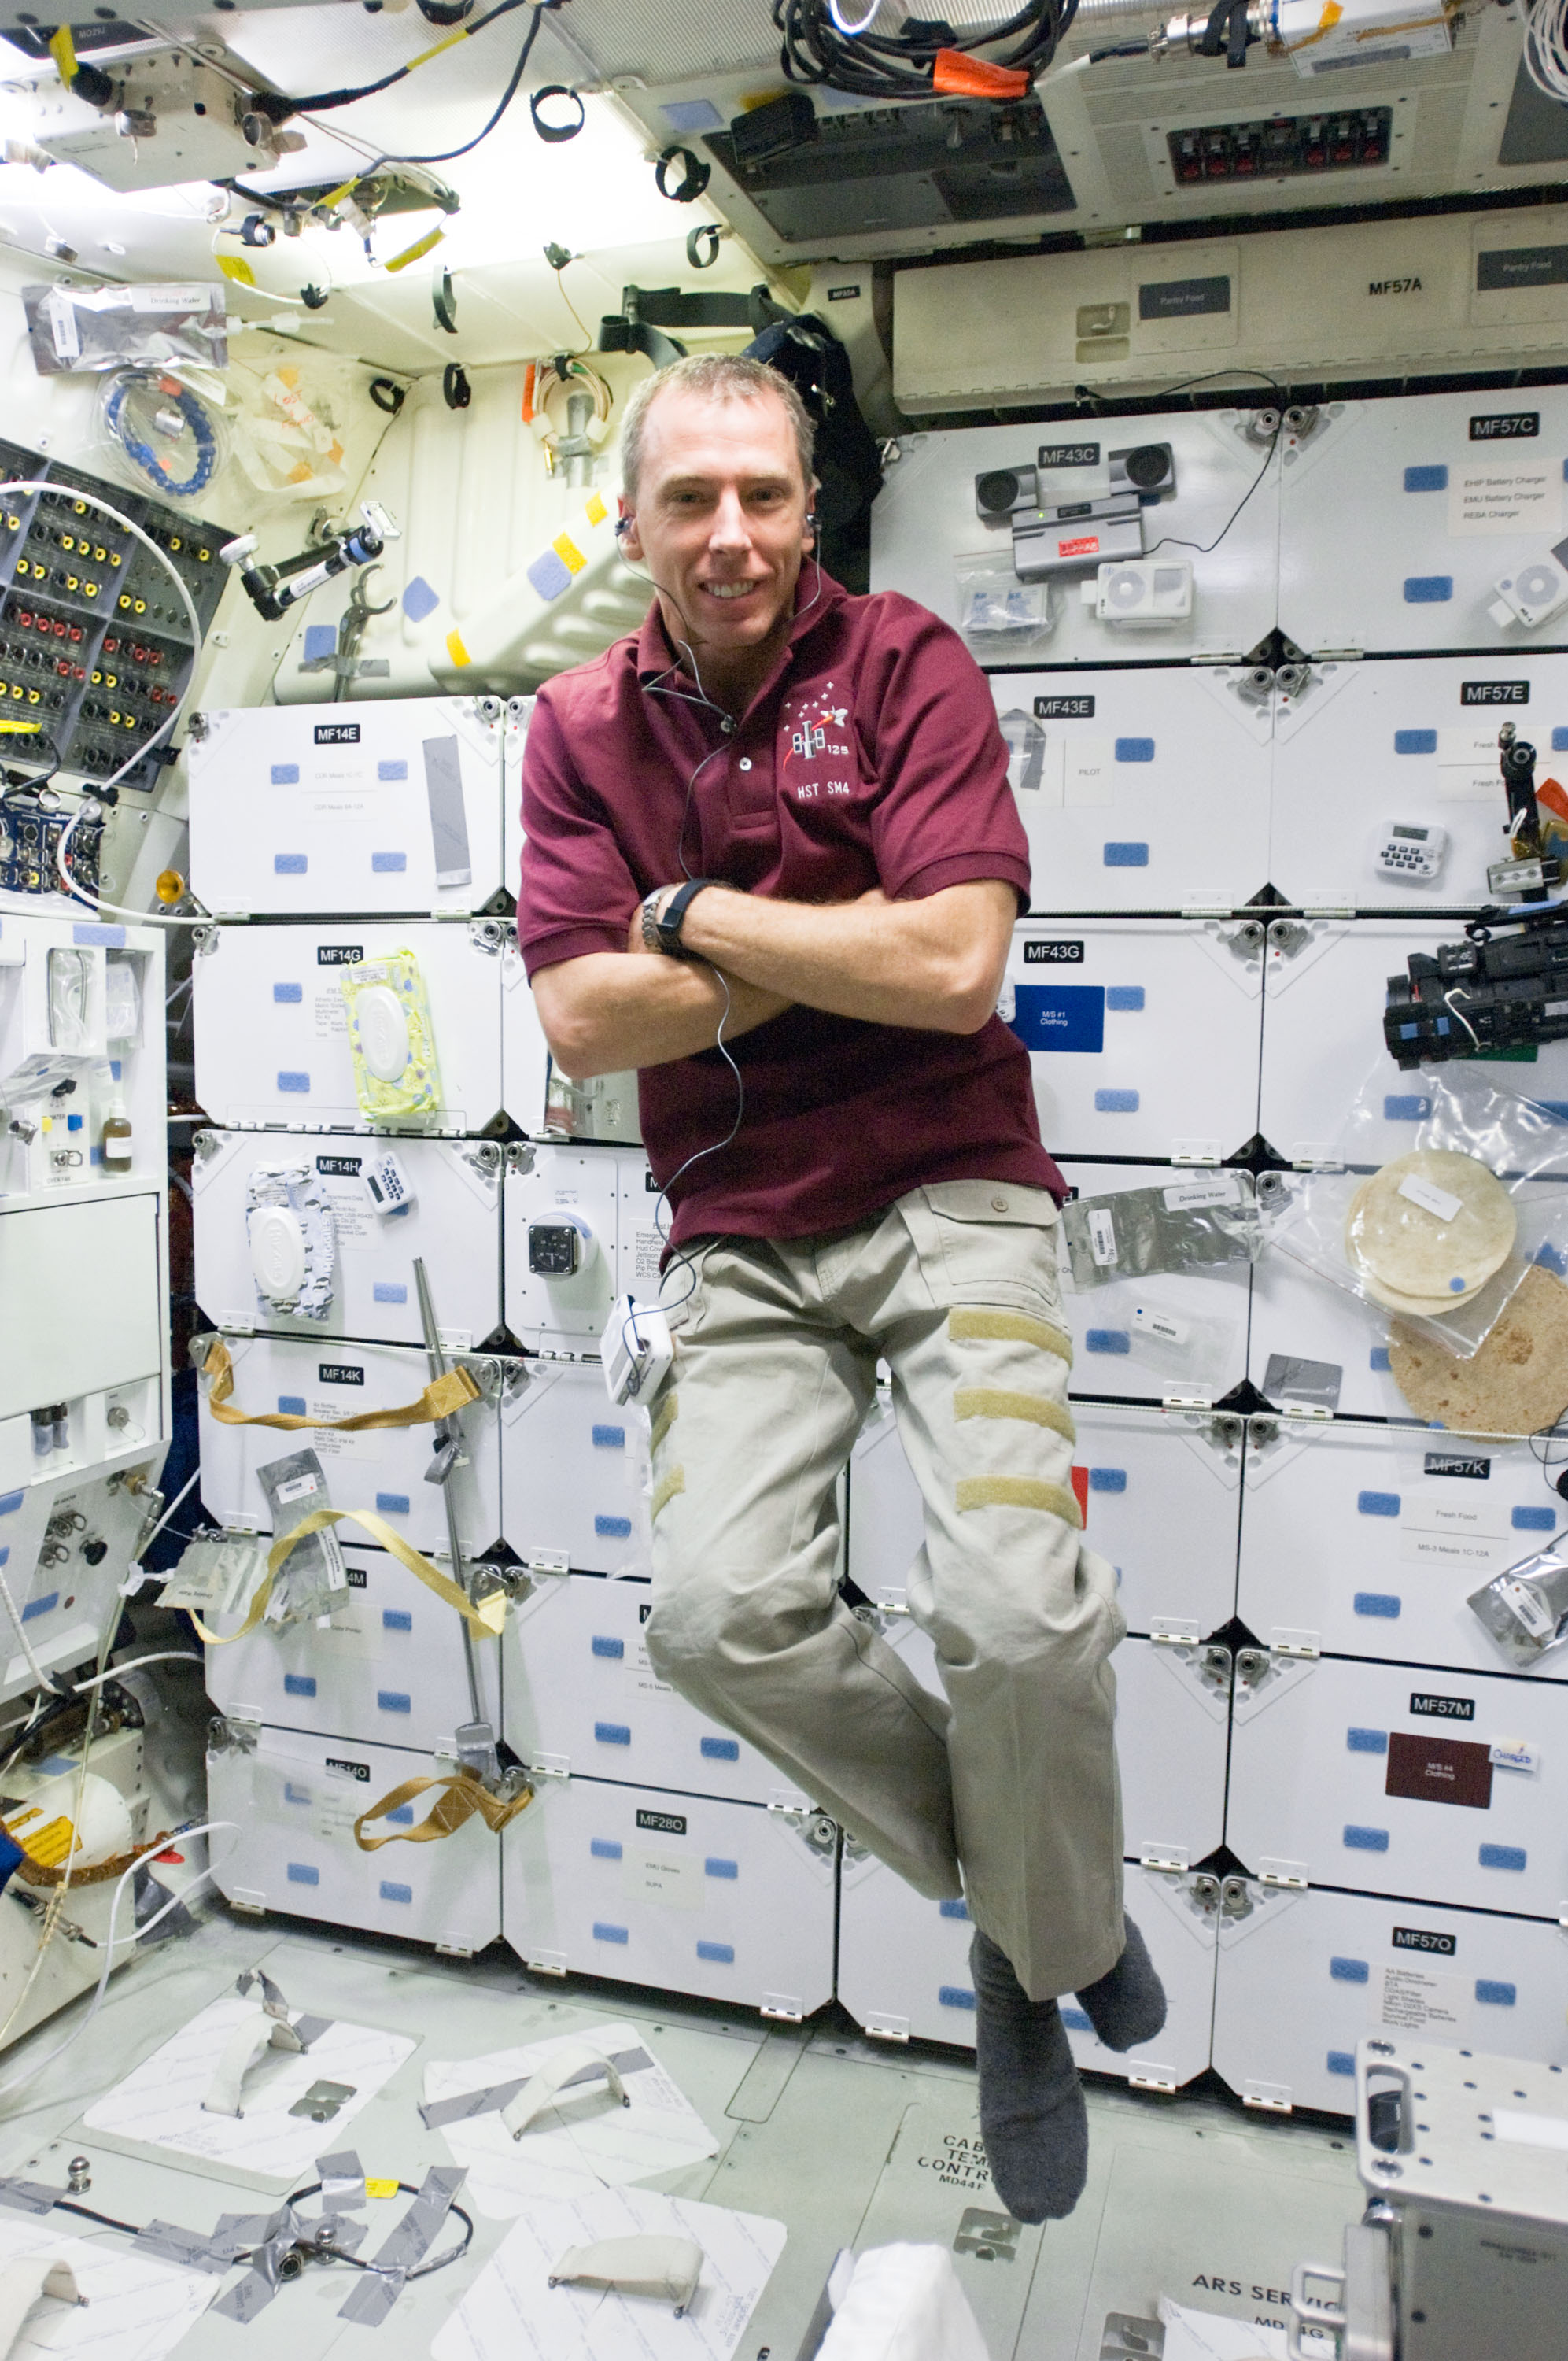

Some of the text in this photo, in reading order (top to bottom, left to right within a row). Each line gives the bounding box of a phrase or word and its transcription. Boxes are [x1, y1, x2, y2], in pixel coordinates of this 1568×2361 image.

[1369, 278, 1422, 296] MF57A
[1474, 417, 1533, 435] MF57C
[1043, 448, 1094, 464] MF43C
[1486, 478, 1513, 487] Battery
[1467, 685, 1524, 700] MF57E
[1039, 700, 1090, 715] MF43E
[317, 728, 356, 741] MF14E
[827, 744, 849, 755] 125
[797, 781, 850, 800] HST SM4
[320, 949, 360, 961] MF14G
[1028, 946, 1079, 959] MF43G
[1040, 1018, 1068, 1027] Clothing
[319, 1159, 359, 1173] MF14H
[1179, 1192, 1206, 1202] Drinking
[323, 1368, 360, 1382] MF14K
[1430, 1458, 1485, 1475] MF57K
[1418, 1543, 1437, 1552] MS-3
[1438, 1546, 1460, 1554] Meals
[1414, 1698, 1470, 1716] MF57M
[1425, 1770, 1455, 1781] Clothing
[640, 1813, 683, 1831] MF28O
[1396, 1931, 1452, 1951] MF57O
[943, 2135, 984, 2152] CAB
[947, 2149, 987, 2167] TEM
[917, 2156, 989, 2181] CONTR
[939, 2174, 985, 2190] MD44F
[1191, 2274, 1242, 2296] ARS
